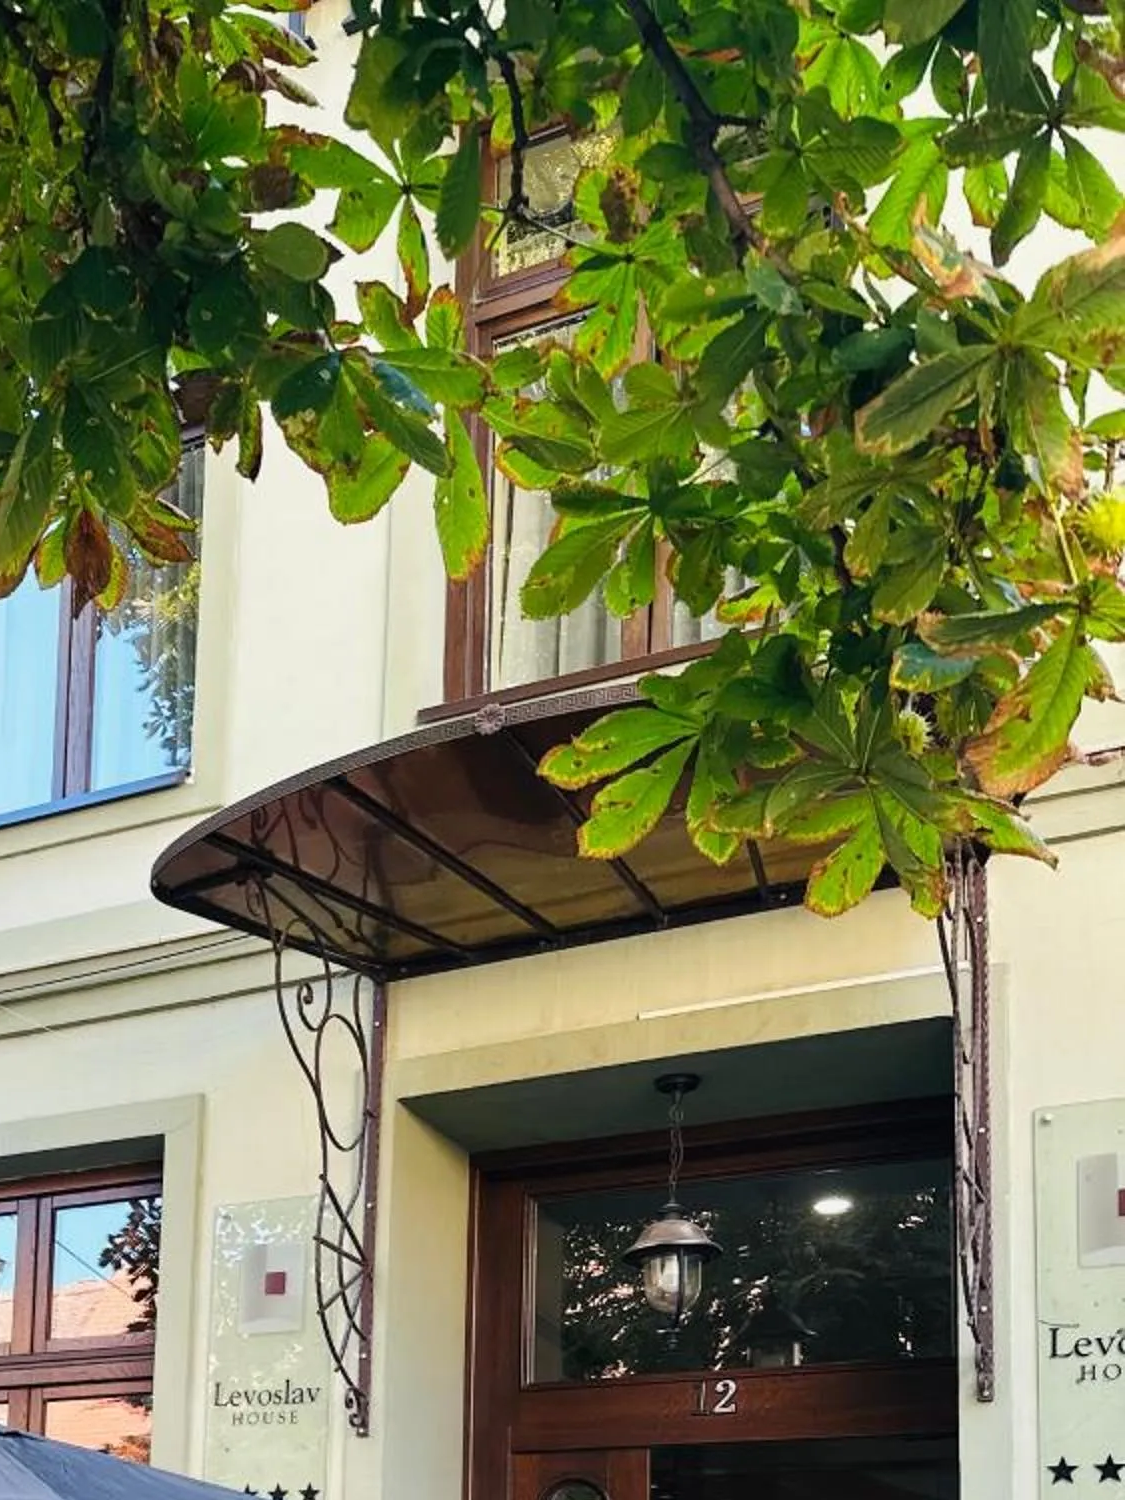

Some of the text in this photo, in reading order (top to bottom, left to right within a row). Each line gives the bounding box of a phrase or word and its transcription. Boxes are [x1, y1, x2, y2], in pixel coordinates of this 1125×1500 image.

[214, 1379, 322, 1406] Levoslav
[691, 1379, 736, 1415] 12
[231, 1410, 299, 1425] HOUSE
